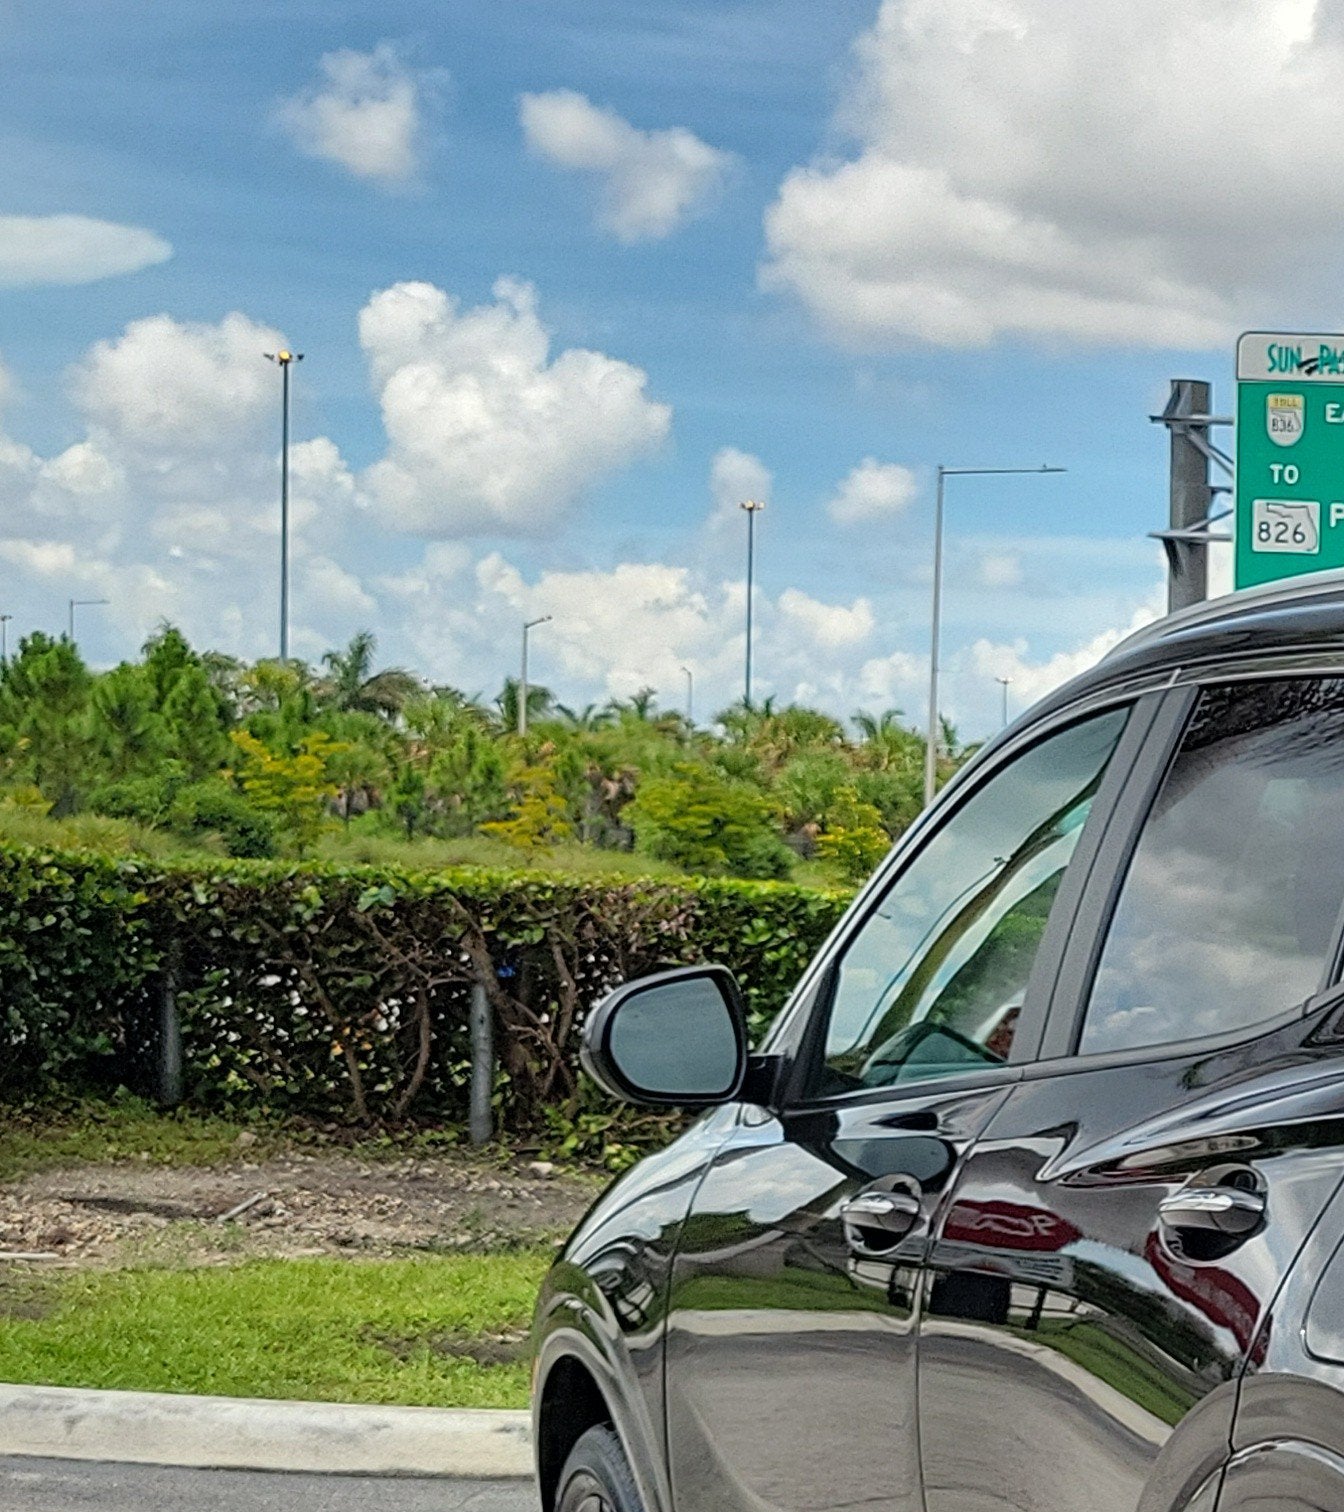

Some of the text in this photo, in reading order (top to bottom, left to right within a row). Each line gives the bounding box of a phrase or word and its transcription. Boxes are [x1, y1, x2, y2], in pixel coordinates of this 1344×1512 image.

[1271, 418, 1295, 433] 836
[1269, 463, 1299, 484] TO
[1258, 521, 1306, 544] 826
